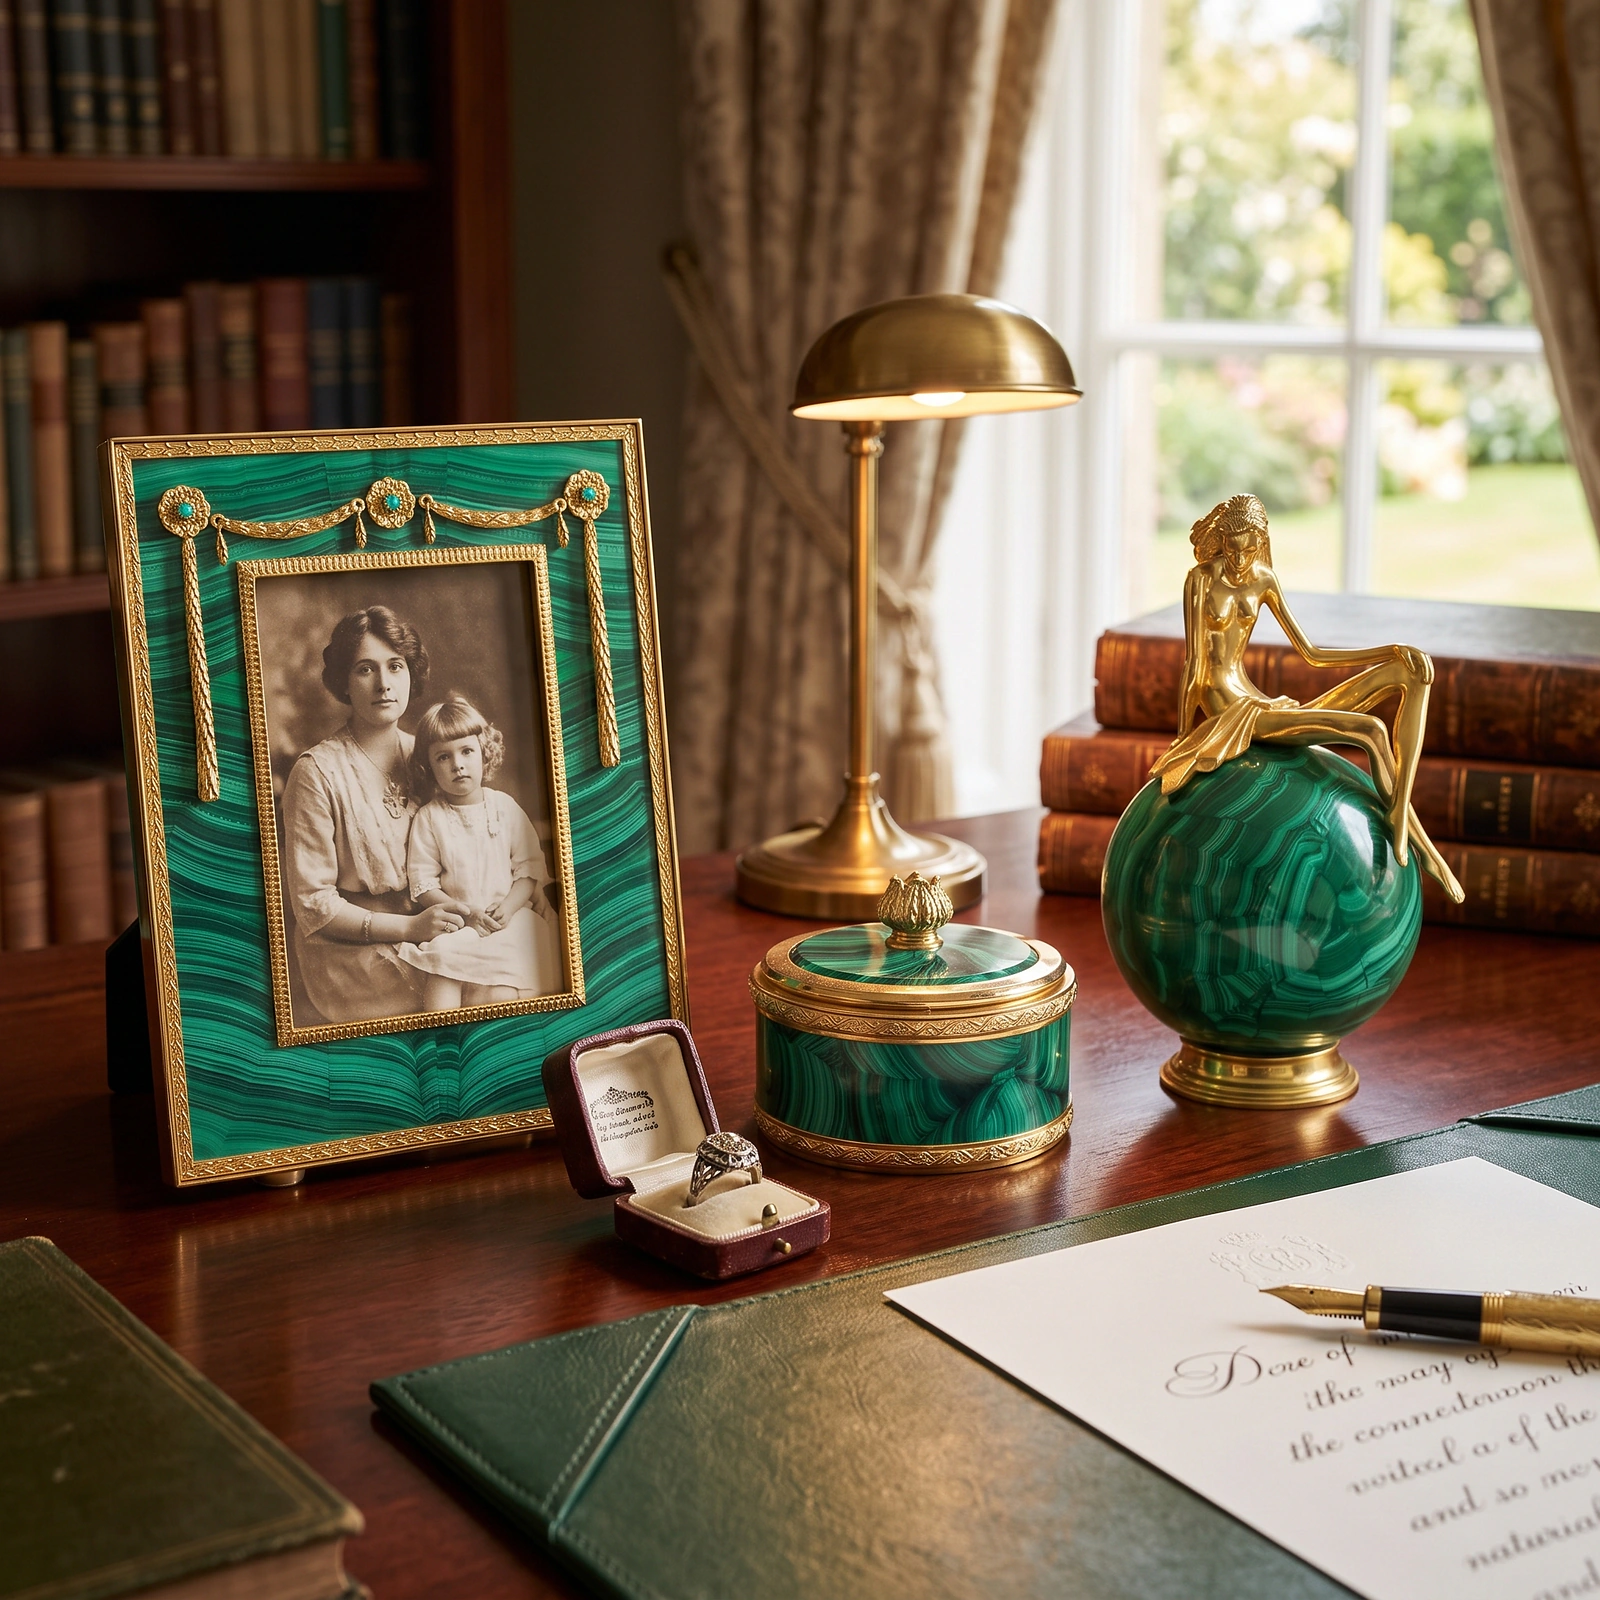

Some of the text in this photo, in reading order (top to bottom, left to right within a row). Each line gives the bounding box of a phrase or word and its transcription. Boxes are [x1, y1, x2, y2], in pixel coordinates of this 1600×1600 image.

[1326, 1335, 1356, 1367] of
[1290, 1432, 1342, 1463] the
[1472, 1442, 1499, 1457] a
[1545, 1403, 1598, 1432] the
[1409, 1483, 1486, 1532] and
